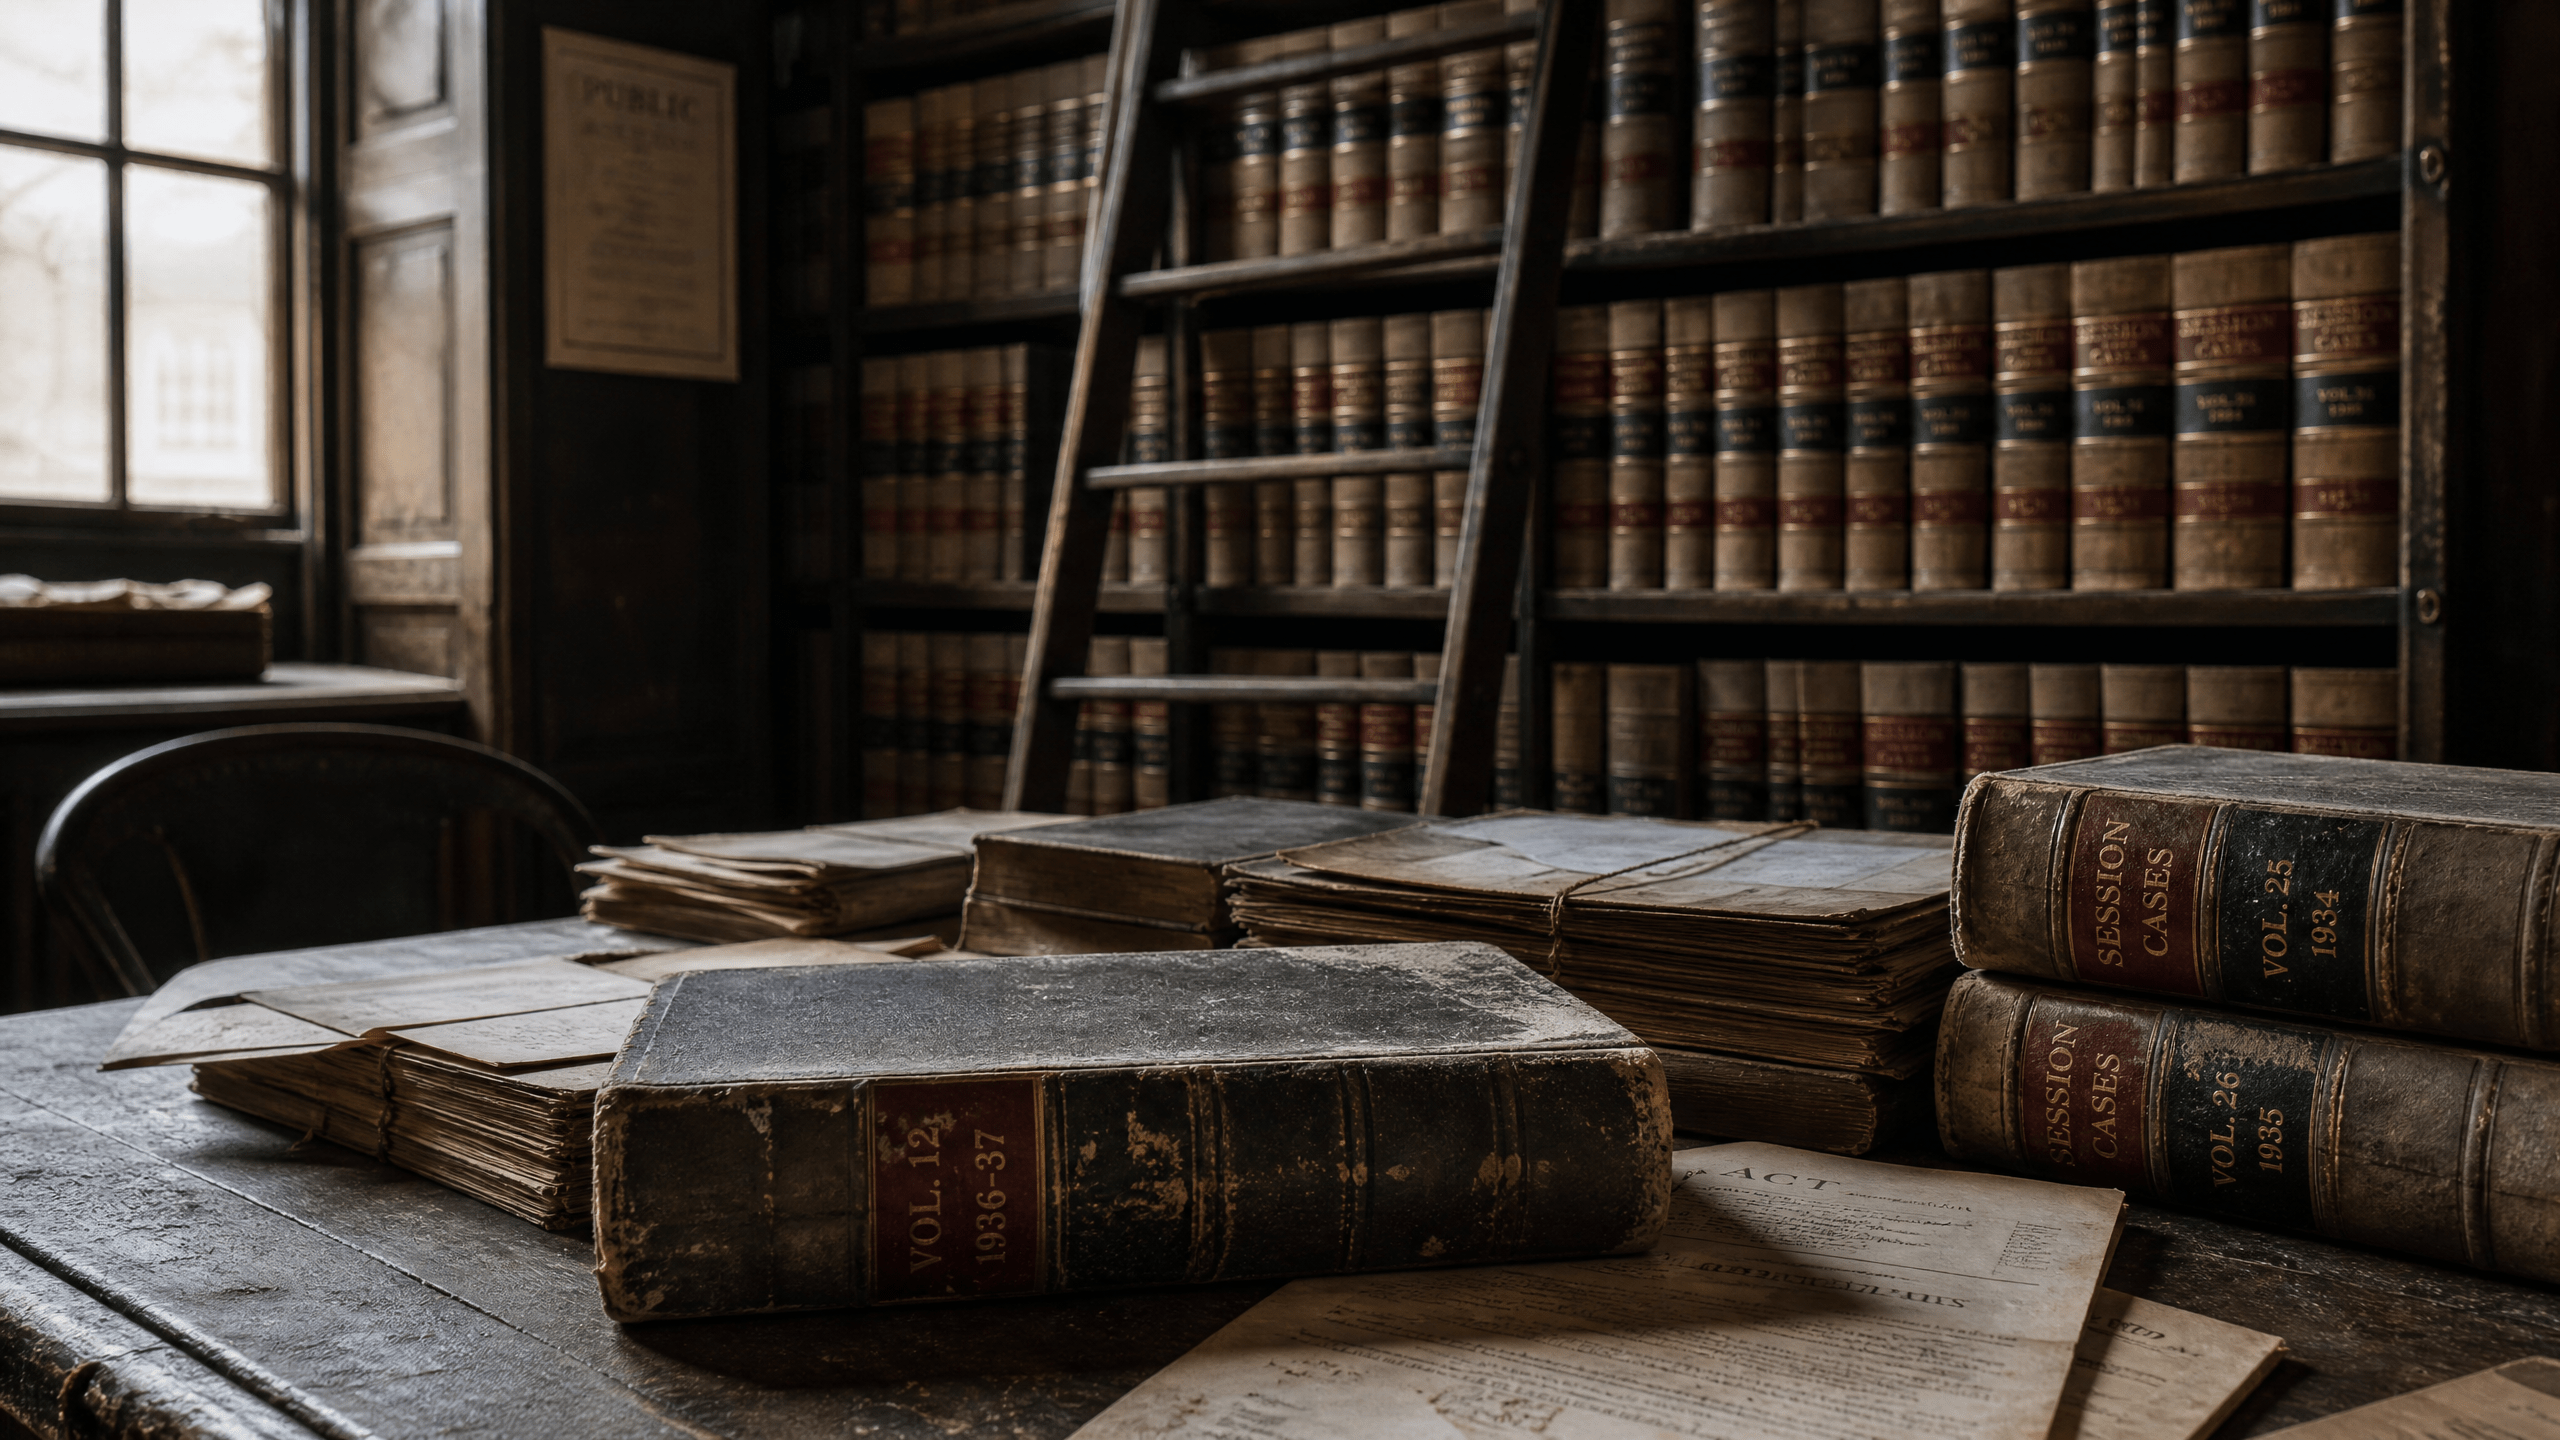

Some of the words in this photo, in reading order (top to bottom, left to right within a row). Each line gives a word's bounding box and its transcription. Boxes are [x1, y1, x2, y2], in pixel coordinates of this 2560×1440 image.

[583, 76, 699, 126] PUBLIC
[2095, 817, 2131, 967] SESSION
[2142, 848, 2174, 957] CASES
[2264, 859, 2293, 896] 25
[2262, 903, 2289, 981] VOL.
[2311, 889, 2340, 958] 1934
[2046, 1020, 2079, 1167] SESSION
[2092, 1053, 2121, 1159] CASES
[2212, 1071, 2240, 1110] 26
[907, 1126, 941, 1168] 12
[2210, 1116, 2237, 1188] VOL.
[2258, 1107, 2284, 1174] 1935
[974, 1129, 1007, 1265] 1936-37
[1719, 1167, 1841, 1191] ACT
[909, 1179, 942, 1274] VOL.
